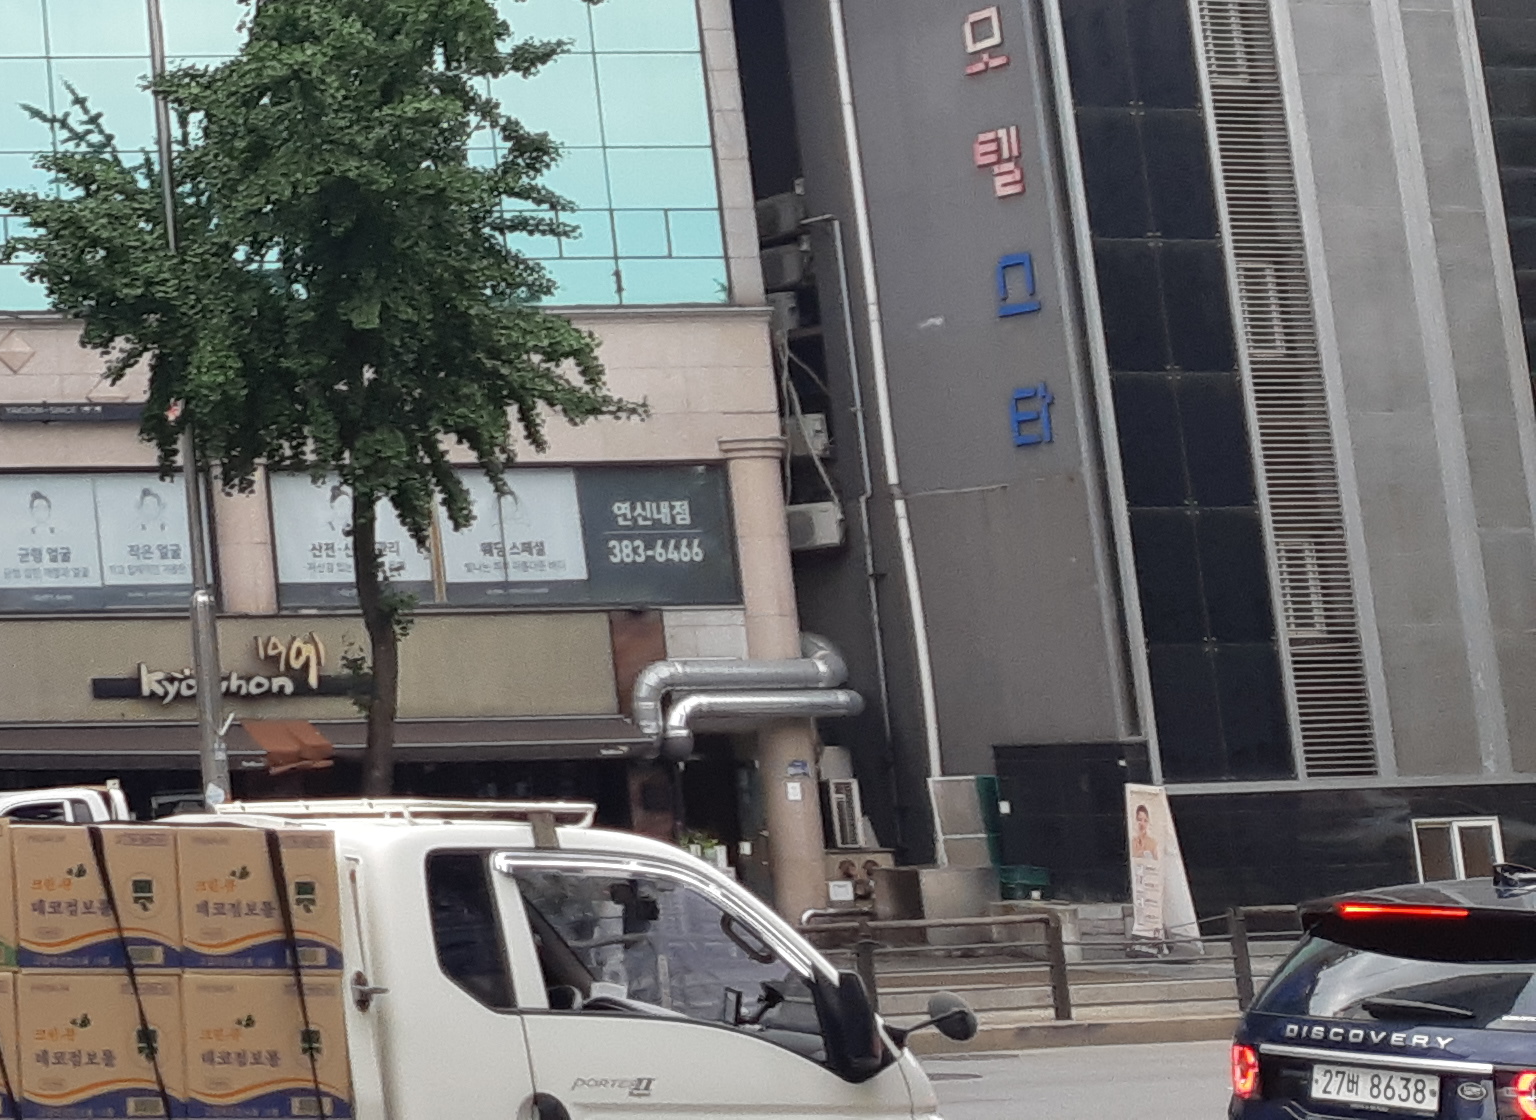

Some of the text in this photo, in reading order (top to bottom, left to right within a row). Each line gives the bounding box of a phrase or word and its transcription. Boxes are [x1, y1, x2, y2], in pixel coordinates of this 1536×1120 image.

[612, 500, 692, 525] 연신내점
[311, 541, 356, 558] 산전·산
[608, 538, 704, 565] 383-6466
[138, 661, 294, 705] kyohon
[1284, 1023, 1455, 1051] DISCOVERY
[1369, 1072, 1428, 1104] 8638
